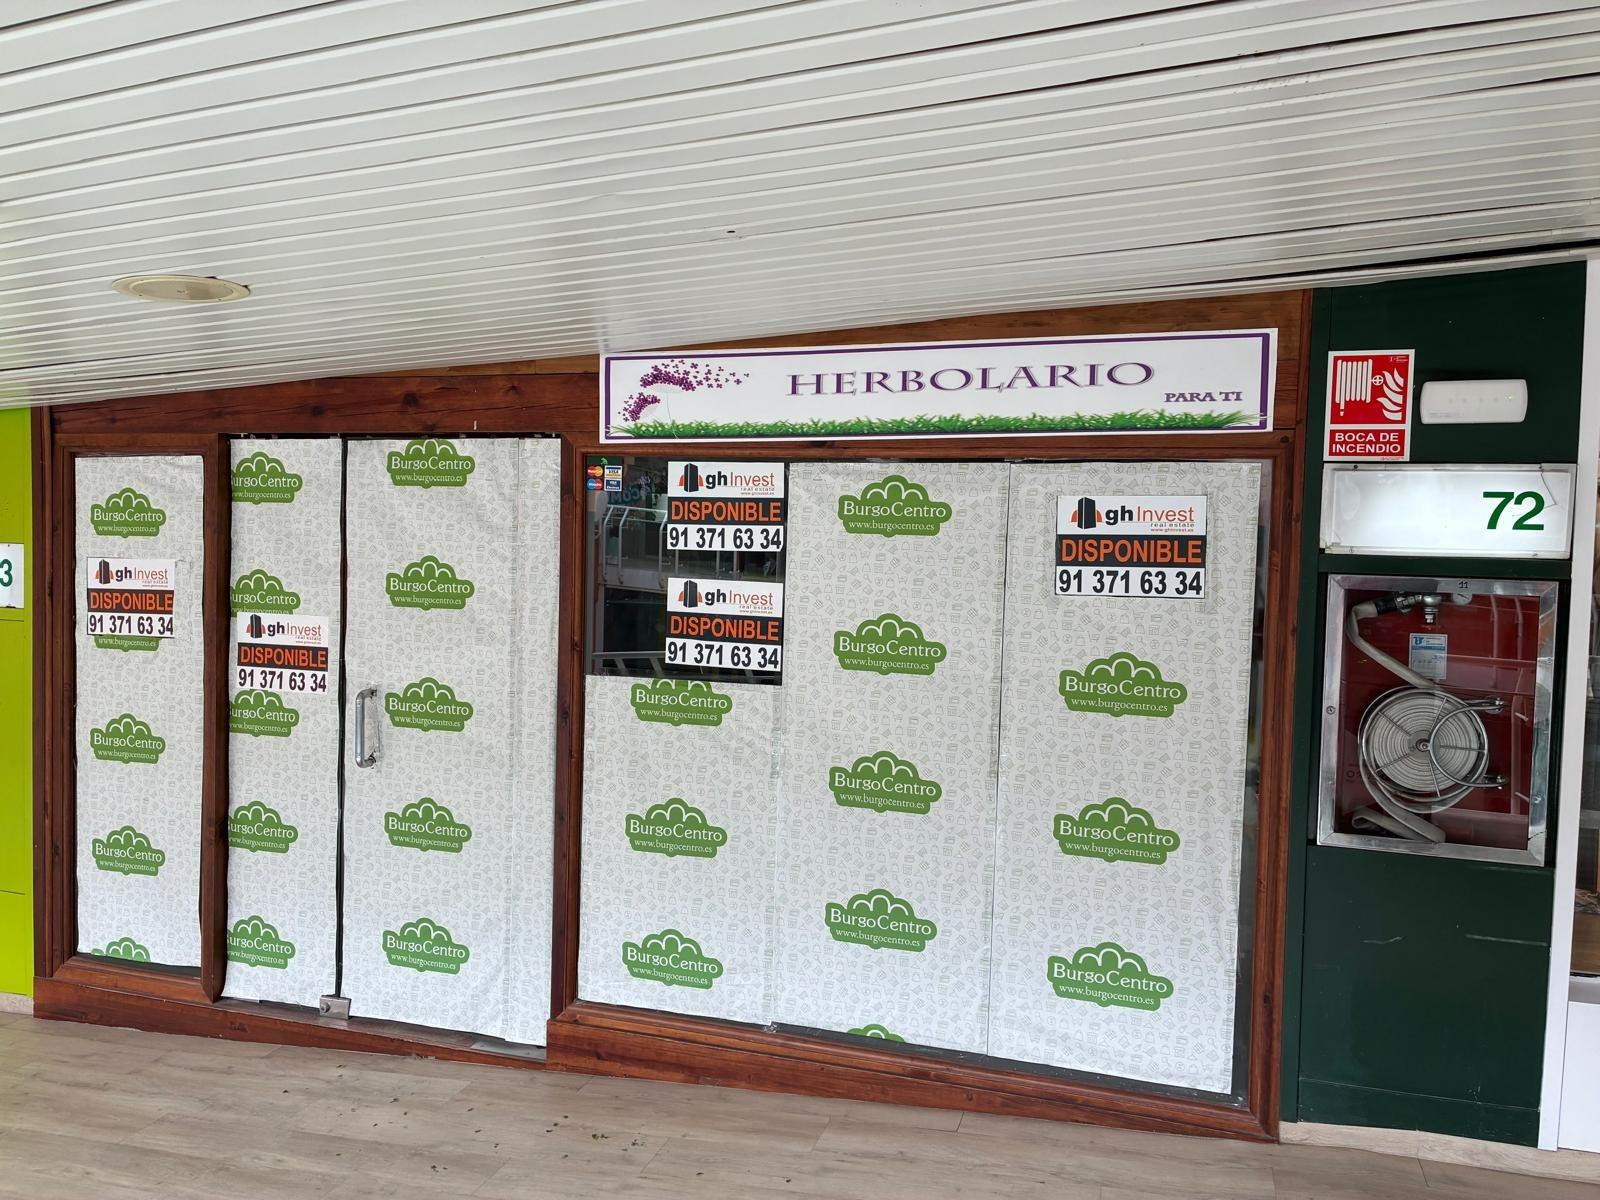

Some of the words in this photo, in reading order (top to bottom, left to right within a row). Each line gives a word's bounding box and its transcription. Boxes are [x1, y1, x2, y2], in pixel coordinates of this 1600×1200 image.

[786, 362, 1154, 396] HERBOLARIO
[1164, 391, 1217, 402] PARA
[1219, 391, 1243, 401] TI
[1335, 432, 1376, 442] BOCA
[1380, 432, 1399, 442] DE
[1332, 443, 1401, 453] INCENDIO
[391, 456, 472, 470] BurgoCentro
[232, 474, 299, 488] urgoCentro
[395, 473, 463, 484] www.burgocentro.es
[94, 508, 163, 522] BurgoCentro
[672, 501, 781, 522] DISPONIBLE
[844, 500, 946, 518] BurgoCentro
[1482, 490, 1546, 531] 72
[98, 524, 156, 534] www.burgocentro.es
[848, 520, 934, 532] www.burgocentro.es
[670, 527, 688, 548] 91
[696, 528, 725, 548] 371
[733, 528, 754, 549] 63
[760, 528, 781, 550] 34
[1062, 539, 1202, 563] DISPONIBLE
[0, 559, 13, 587] 3
[390, 578, 470, 594] BurgoCentro
[1059, 569, 1082, 592] 91
[1092, 570, 1130, 594] 371
[1140, 570, 1166, 594] 63
[1175, 571, 1202, 596] 34
[90, 592, 173, 610] DISPONIBLE
[231, 591, 297, 606] urgoCentro
[394, 594, 462, 606] www.burgocentro.es
[90, 614, 104, 632] 91
[109, 615, 132, 634] 371
[138, 616, 154, 634] 63
[158, 616, 174, 636] 34
[670, 616, 779, 640] DISPONIBLE
[668, 642, 686, 662] 91
[694, 643, 723, 665] 371
[730, 646, 752, 668] 63
[758, 648, 779, 668] 34
[839, 636, 941, 658] BurgoCentro
[240, 646, 327, 668] DISPONIBLE
[844, 657, 930, 671] www.burgocentro.es
[239, 668, 254, 687] 91
[260, 670, 283, 689] 371
[289, 672, 306, 691] 63
[310, 673, 326, 692] 34
[1065, 676, 1181, 699] BurgoCentro
[389, 697, 470, 716] BurgoCentro
[636, 688, 728, 710] BurgoCentro
[1072, 696, 1168, 713] www.burgocentro.es
[230, 706, 296, 722] urgoCentro
[394, 714, 461, 728] www.burgocentro.es
[640, 708, 718, 723] www.burgocentro.es
[94, 732, 162, 750] BurgoCentro
[98, 748, 156, 761] www.burgocentro.es
[834, 772, 936, 797] BurgoCentro
[840, 792, 925, 810] www.burgocentro.es
[228, 822, 294, 838] urgoCentro
[388, 816, 468, 838] BurgoCentro
[630, 819, 722, 842] BurgoCentro
[1059, 820, 1174, 847] BurgoCentro
[392, 834, 459, 850] www.burgocentro.es
[634, 838, 713, 854] www.burgocentro.es
[1065, 841, 1161, 860] www.burgocentro.es
[95, 844, 162, 862] BurgoCentro
[99, 858, 156, 872] www.burgocentro.es
[830, 908, 932, 936] BurgoCentro
[227, 936, 292, 954] urgoCentro
[386, 935, 466, 958] BurgoCentro
[836, 928, 920, 947] www.burgocentro.es
[390, 953, 456, 970] www.burgocentro.es
[627, 947, 718, 974] BurgoCentro
[632, 967, 708, 986] www.burgocentro.es
[1054, 962, 1167, 993] BurgoCentro
[1059, 983, 1155, 1006] www.burgocentro.es
